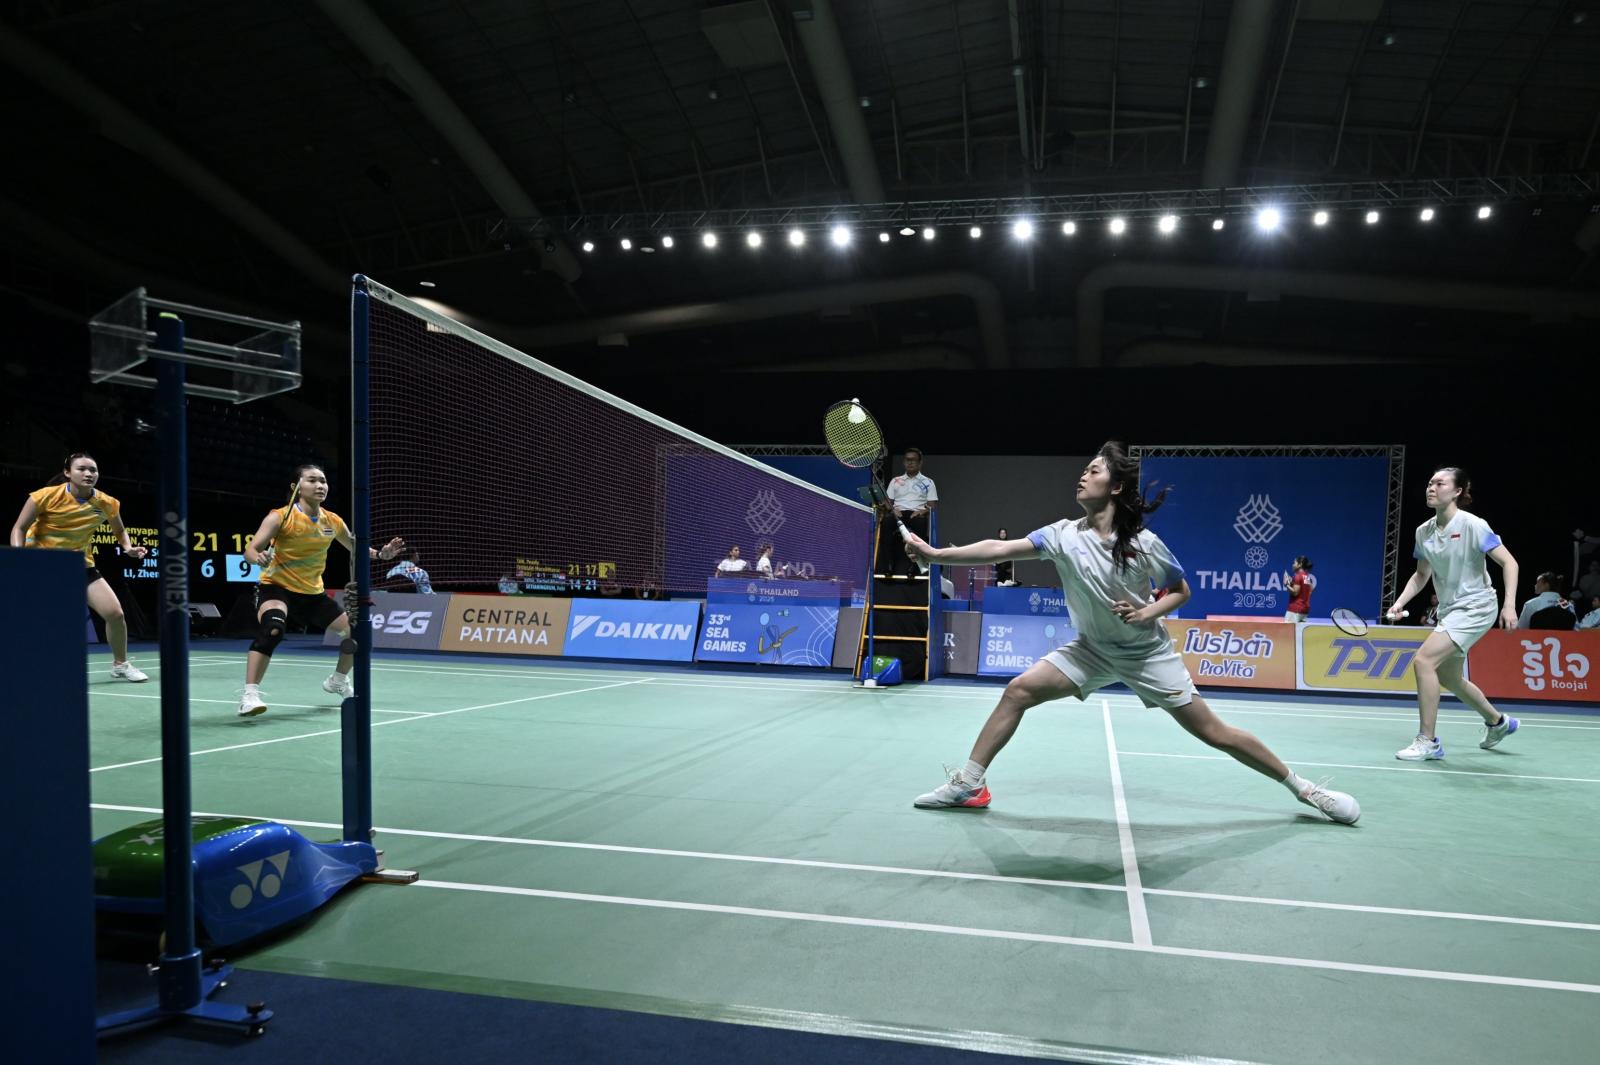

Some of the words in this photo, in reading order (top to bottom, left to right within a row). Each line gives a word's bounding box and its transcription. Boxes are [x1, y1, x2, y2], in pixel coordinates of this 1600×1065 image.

[126, 528, 159, 536] enyapa
[193, 532, 218, 552] 21
[142, 558, 158, 567] JIN
[201, 559, 215, 578] 6
[239, 560, 251, 578] 9
[165, 552, 188, 613] YONEX
[1196, 571, 1317, 591] THAILAD
[760, 588, 799, 597] THAILAND
[1233, 593, 1277, 608] 2025
[384, 611, 432, 635] 5G
[462, 608, 552, 626] CENTRAL
[459, 626, 548, 646] PATTANA
[595, 621, 693, 641] DAIKIN
[705, 626, 729, 639] SEA
[703, 639, 747, 653] GAMES
[986, 640, 1013, 653] SEA
[985, 654, 1033, 667] GAMES
[1199, 660, 1254, 678] ProVita
[1520, 636, 1590, 691] รู้ใจ
[1552, 679, 1588, 691] Roojai
